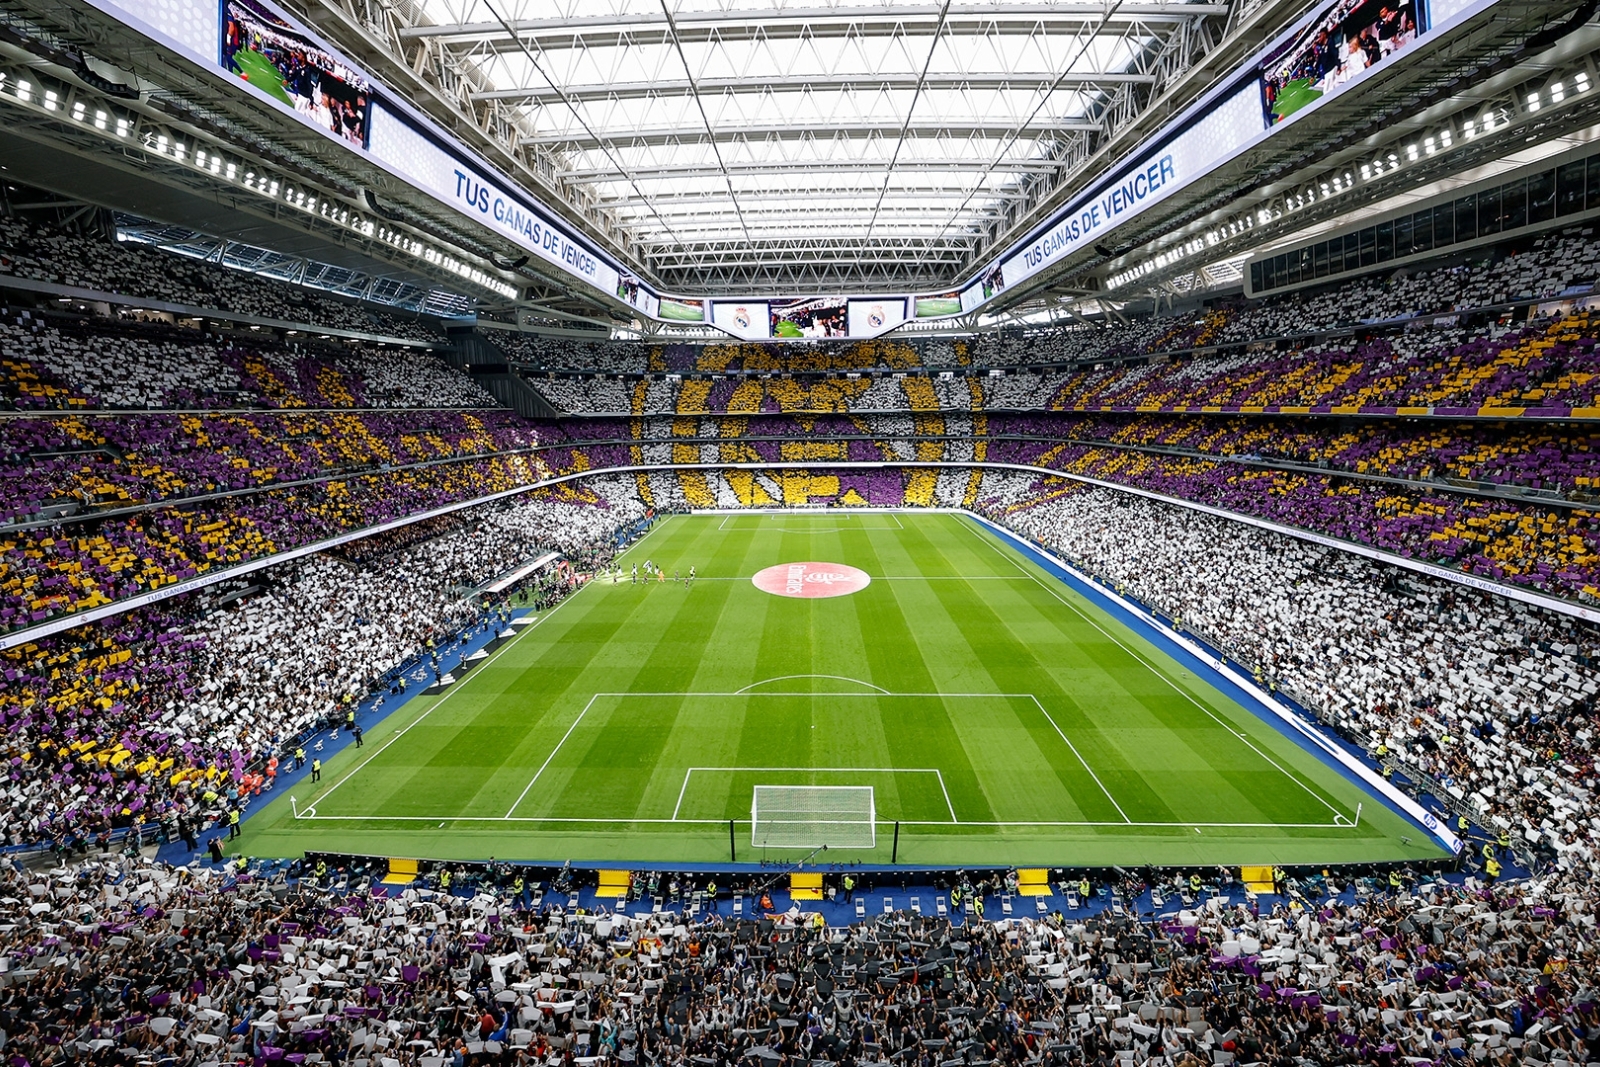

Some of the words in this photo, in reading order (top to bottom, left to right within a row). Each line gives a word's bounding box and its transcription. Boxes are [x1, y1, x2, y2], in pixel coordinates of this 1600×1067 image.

[454, 169, 489, 214] TUS
[493, 197, 541, 245] GANAS
[543, 230, 558, 255] DE
[561, 240, 597, 277] VENCER
[1024, 245, 1043, 270] TUS
[1043, 220, 1080, 257] GANAS
[1081, 205, 1101, 233] DE
[1102, 154, 1175, 219] VENCER
[147, 592, 162, 602] TUS
[163, 585, 189, 597] GANAS
[190, 581, 200, 590] DE
[200, 573, 226, 585] VENCER
[1423, 566, 1437, 574] TUS
[1438, 570, 1464, 582] GANAS
[1465, 578, 1476, 586] DE
[1477, 581, 1512, 596] VENCER
[1424, 813, 1437, 830] hp
